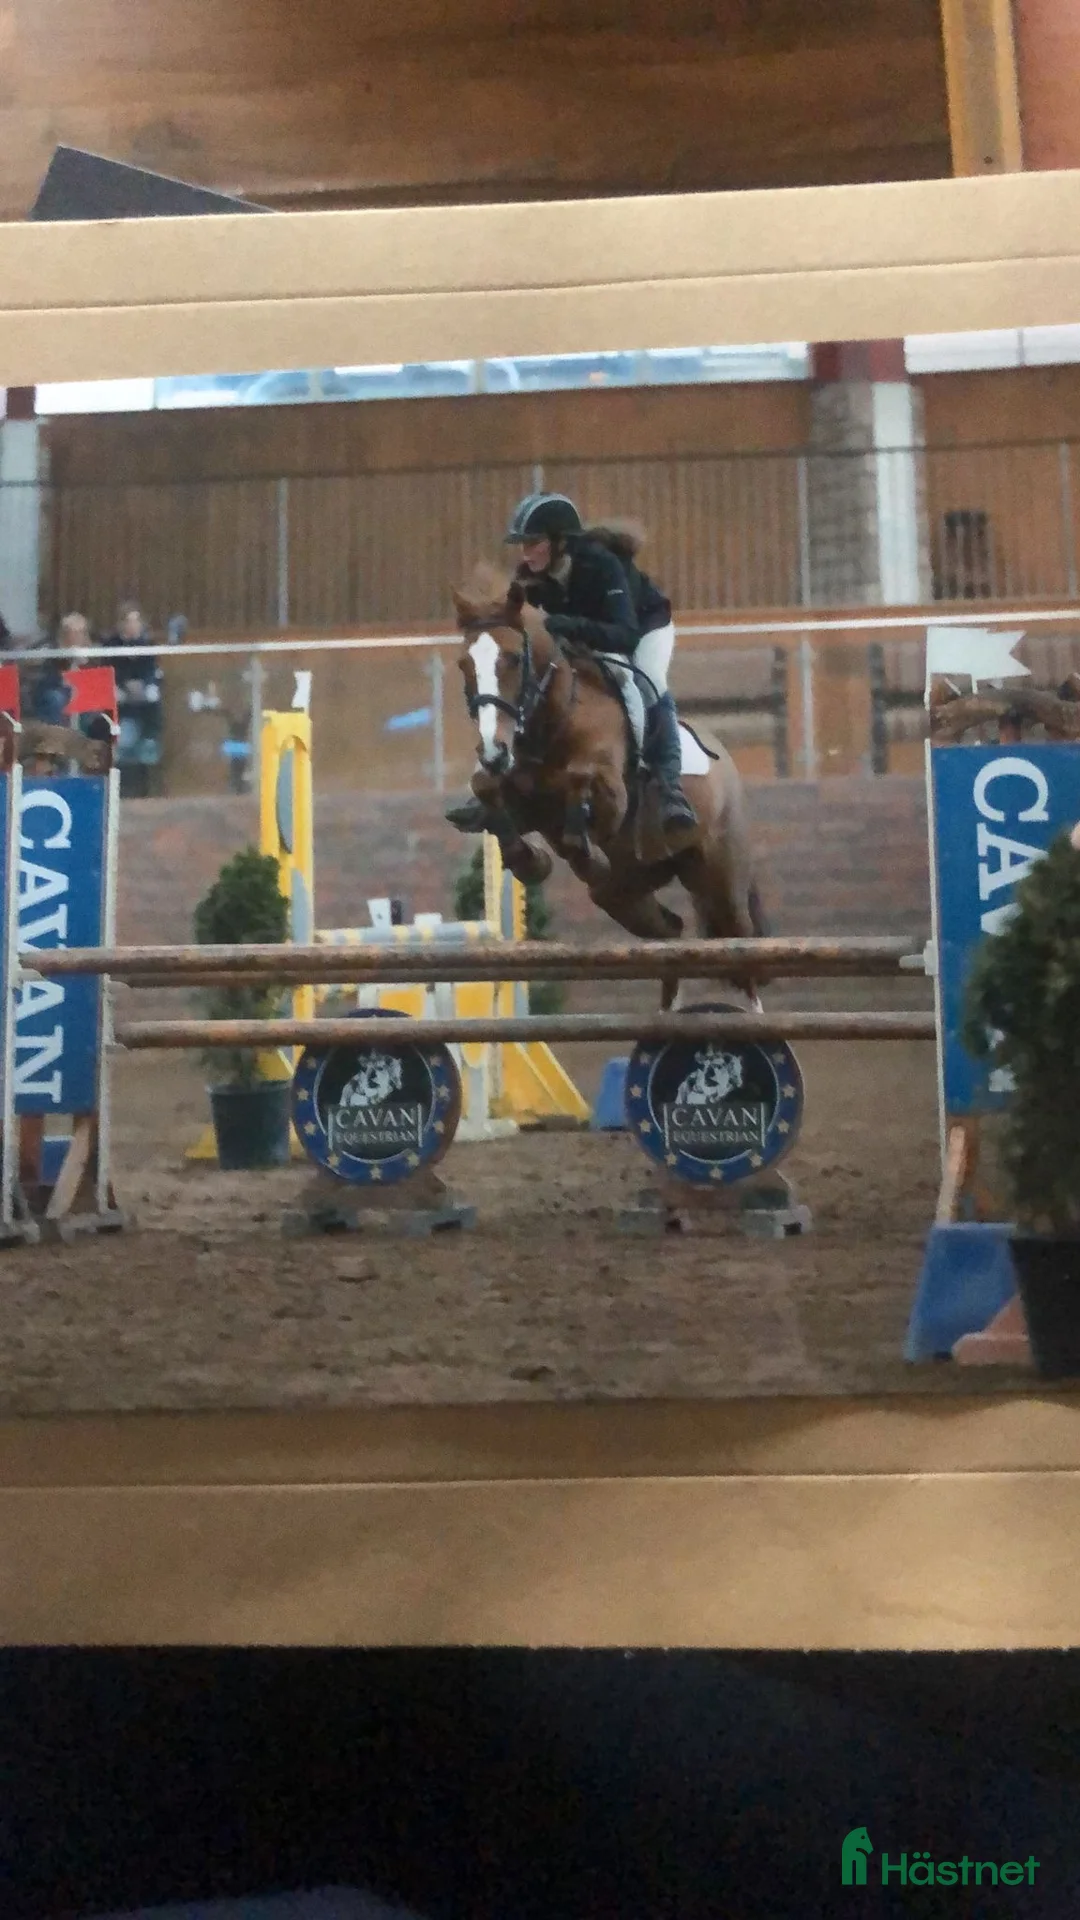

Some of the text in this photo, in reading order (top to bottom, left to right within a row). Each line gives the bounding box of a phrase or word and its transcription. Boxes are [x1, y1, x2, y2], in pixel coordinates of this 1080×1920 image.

[335, 1108, 417, 1128] CAVAN
[671, 1107, 758, 1127] CAVAN
[672, 1130, 759, 1145] EQUESTRIAN
